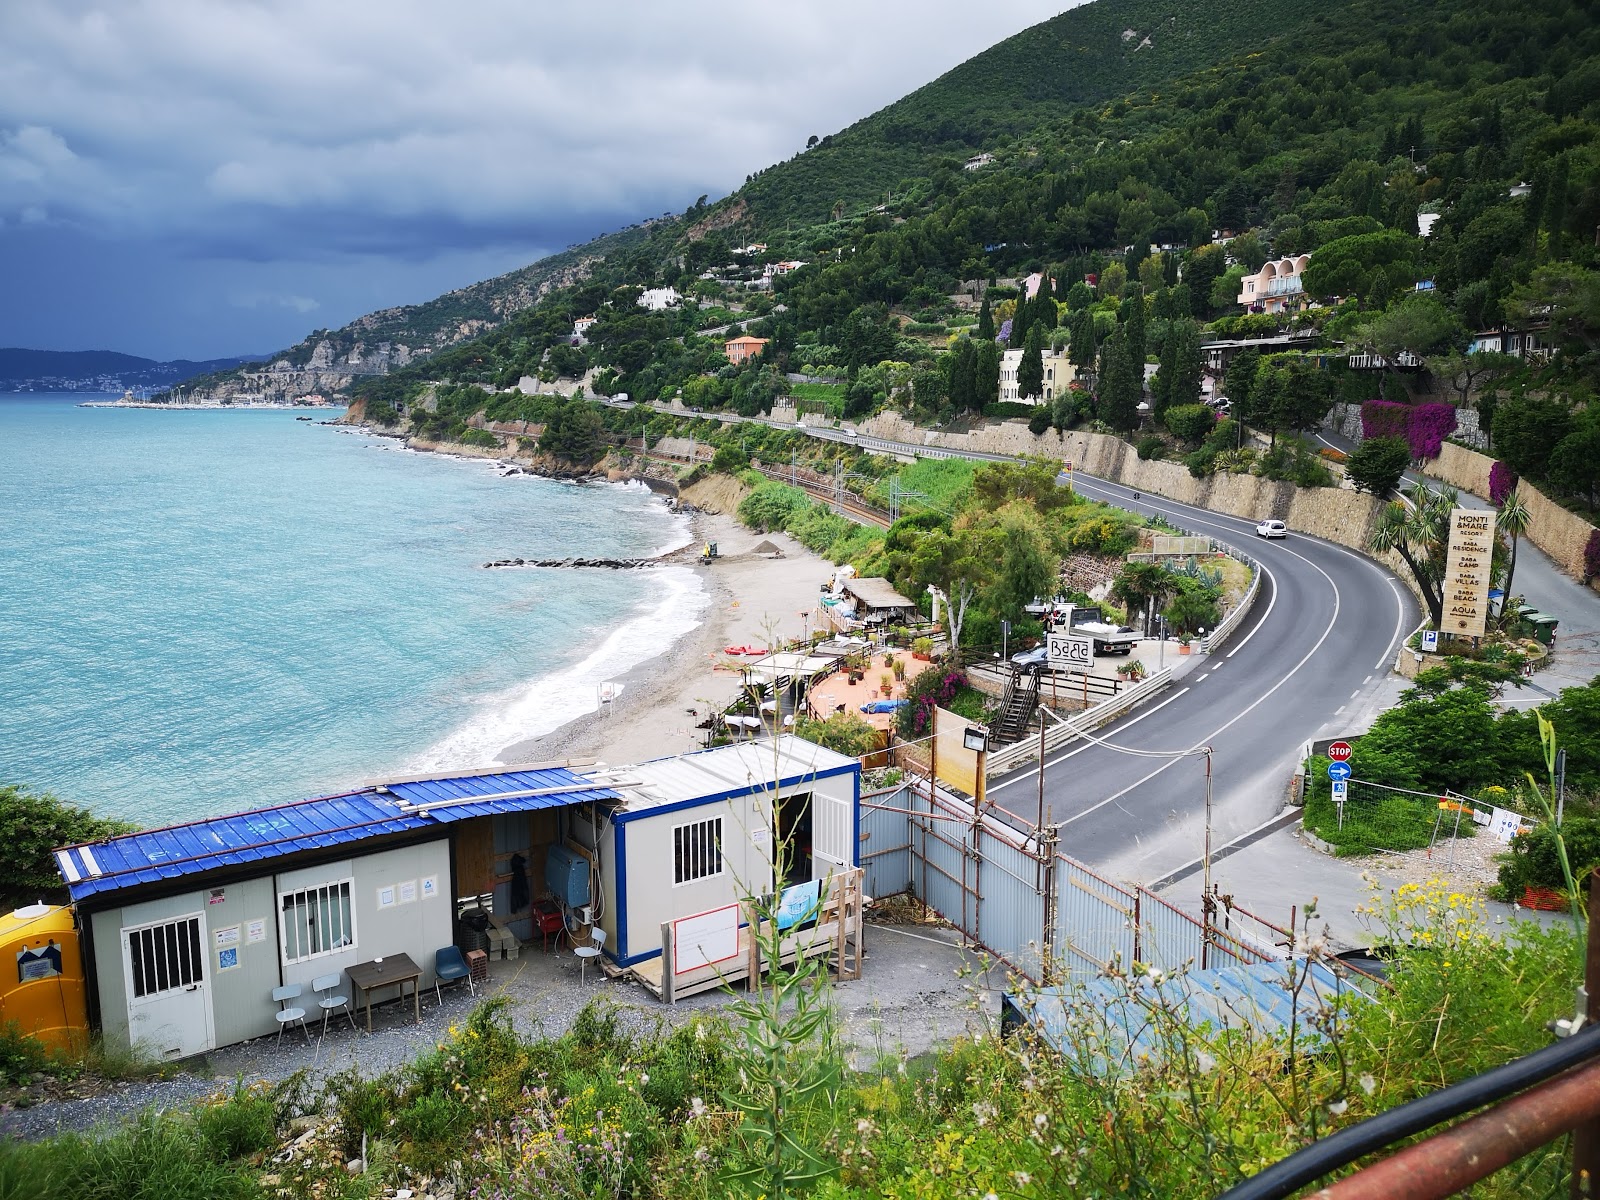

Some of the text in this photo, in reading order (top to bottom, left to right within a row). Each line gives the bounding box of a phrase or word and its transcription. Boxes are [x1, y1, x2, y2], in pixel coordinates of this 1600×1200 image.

[1456, 522, 1489, 530] &MARE
[1452, 545, 1488, 553] RESIDENCE
[1452, 606, 1476, 614] AQUA
[1426, 632, 1434, 640] P
[1330, 748, 1350, 756] STOP
